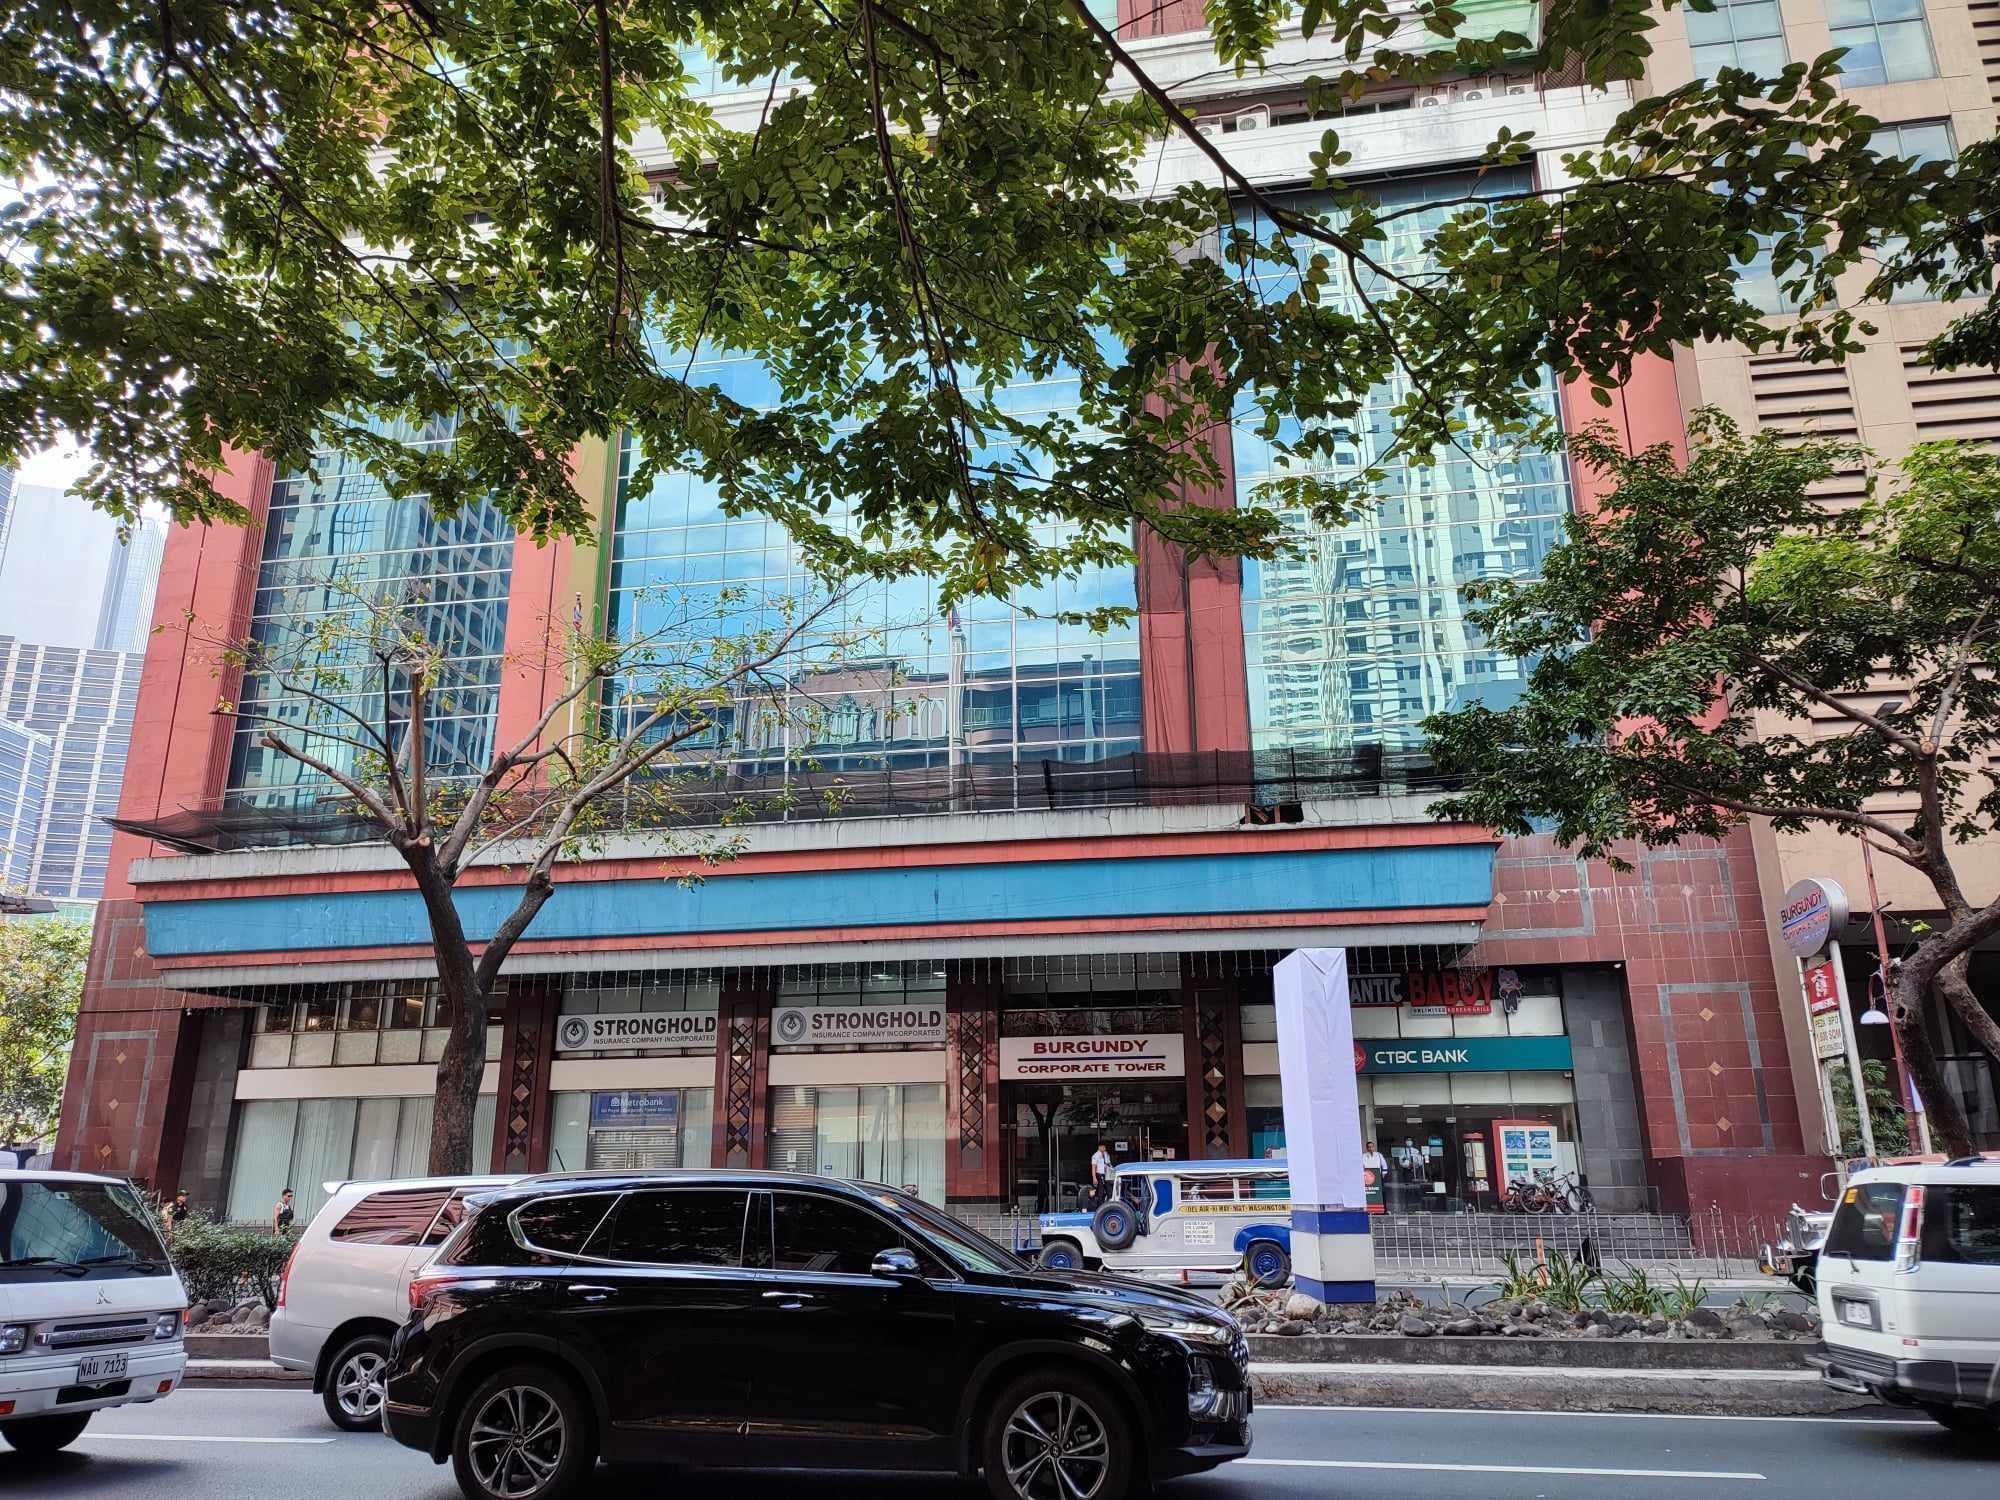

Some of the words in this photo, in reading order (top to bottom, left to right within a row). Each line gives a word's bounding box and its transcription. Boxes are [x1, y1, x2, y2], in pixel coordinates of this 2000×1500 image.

[1780, 889, 1822, 923] BURGUNDY
[1408, 967, 1492, 1007] BABOY
[593, 1016, 717, 1037] STRONGHOLD
[812, 1010, 942, 1030] STRONGHOLD
[593, 1037, 631, 1045] INSURANCE
[632, 1036, 662, 1044] COMPANY
[664, 1034, 715, 1043] INCORPORATED
[812, 1031, 851, 1039] INSURANCE
[852, 1030, 884, 1038] COMPANY
[887, 1029, 941, 1037] INCORPORATED
[1033, 1039, 1149, 1055] BURGUNDY
[1374, 1050, 1418, 1065] CTBC
[1421, 1048, 1470, 1064] BANK
[1017, 1063, 1111, 1074] CORPORATE
[1114, 1062, 1167, 1072] TOWER
[80, 1361, 99, 1377] NAU
[103, 1358, 127, 1374] 7123
